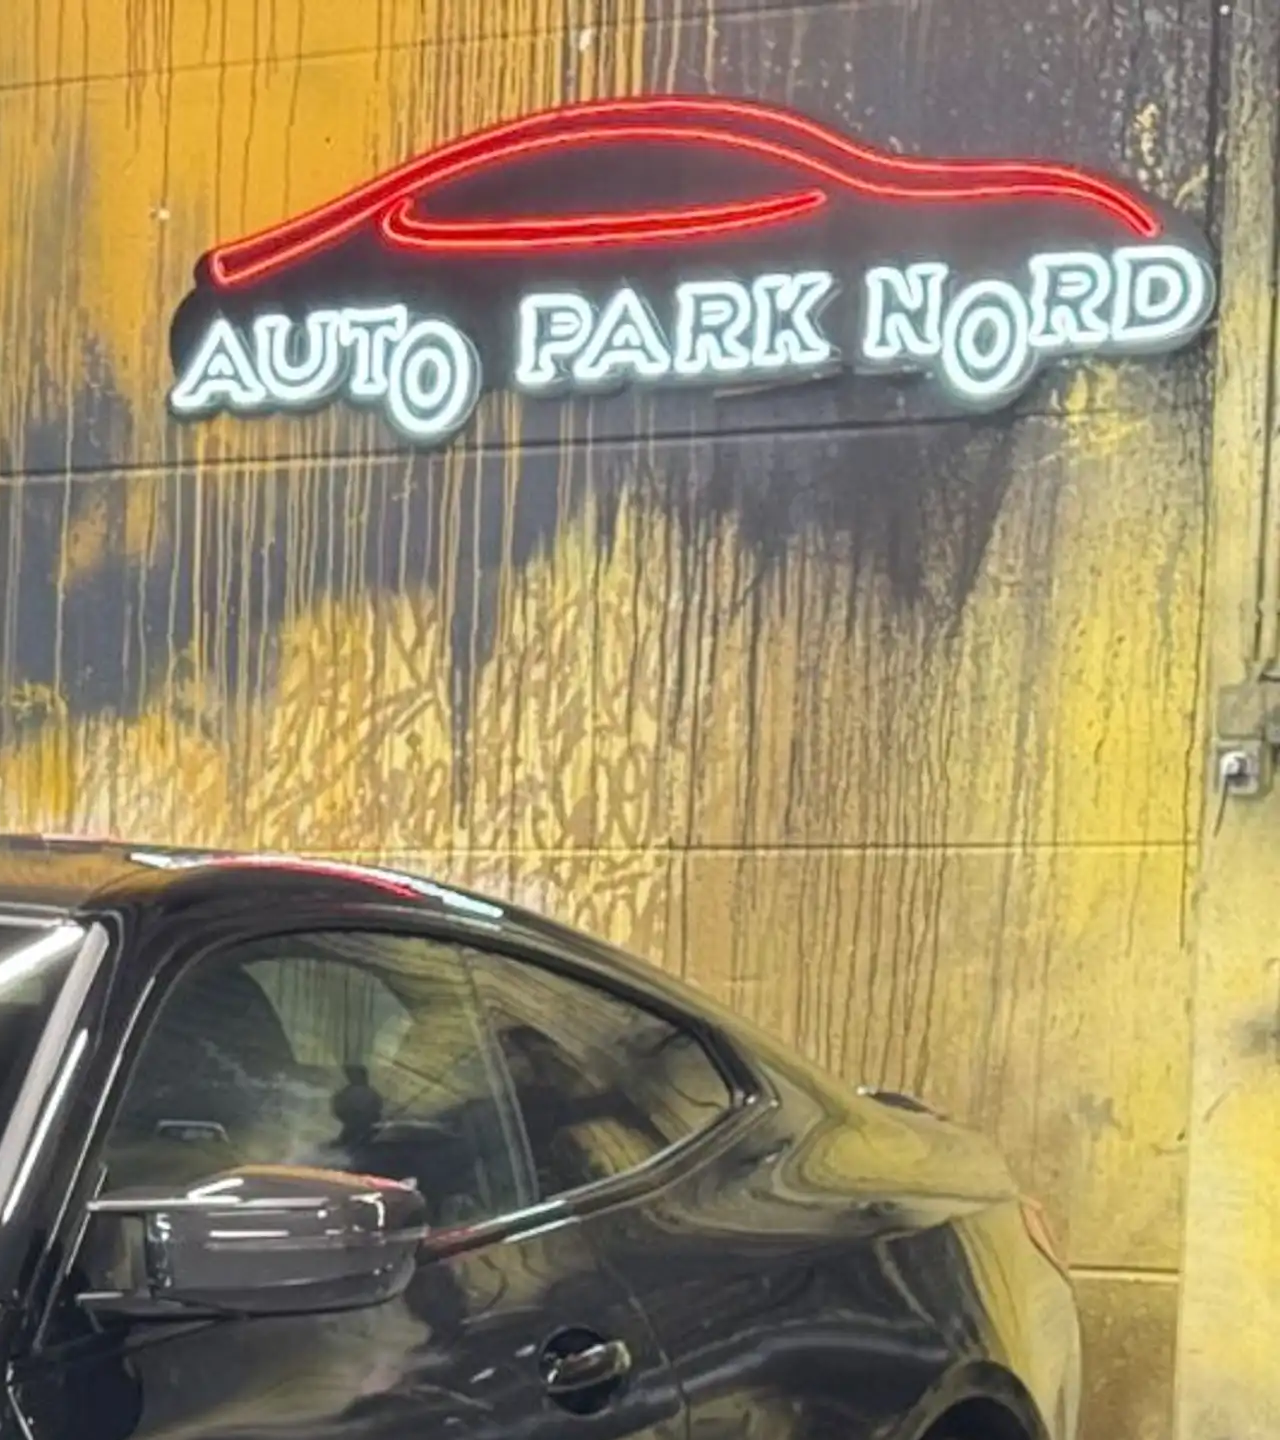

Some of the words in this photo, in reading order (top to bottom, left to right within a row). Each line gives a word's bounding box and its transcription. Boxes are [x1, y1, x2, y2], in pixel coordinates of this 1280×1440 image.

[169, 305, 474, 436] AUTO
[513, 268, 833, 386] PARK
[861, 242, 1210, 398] NORD
